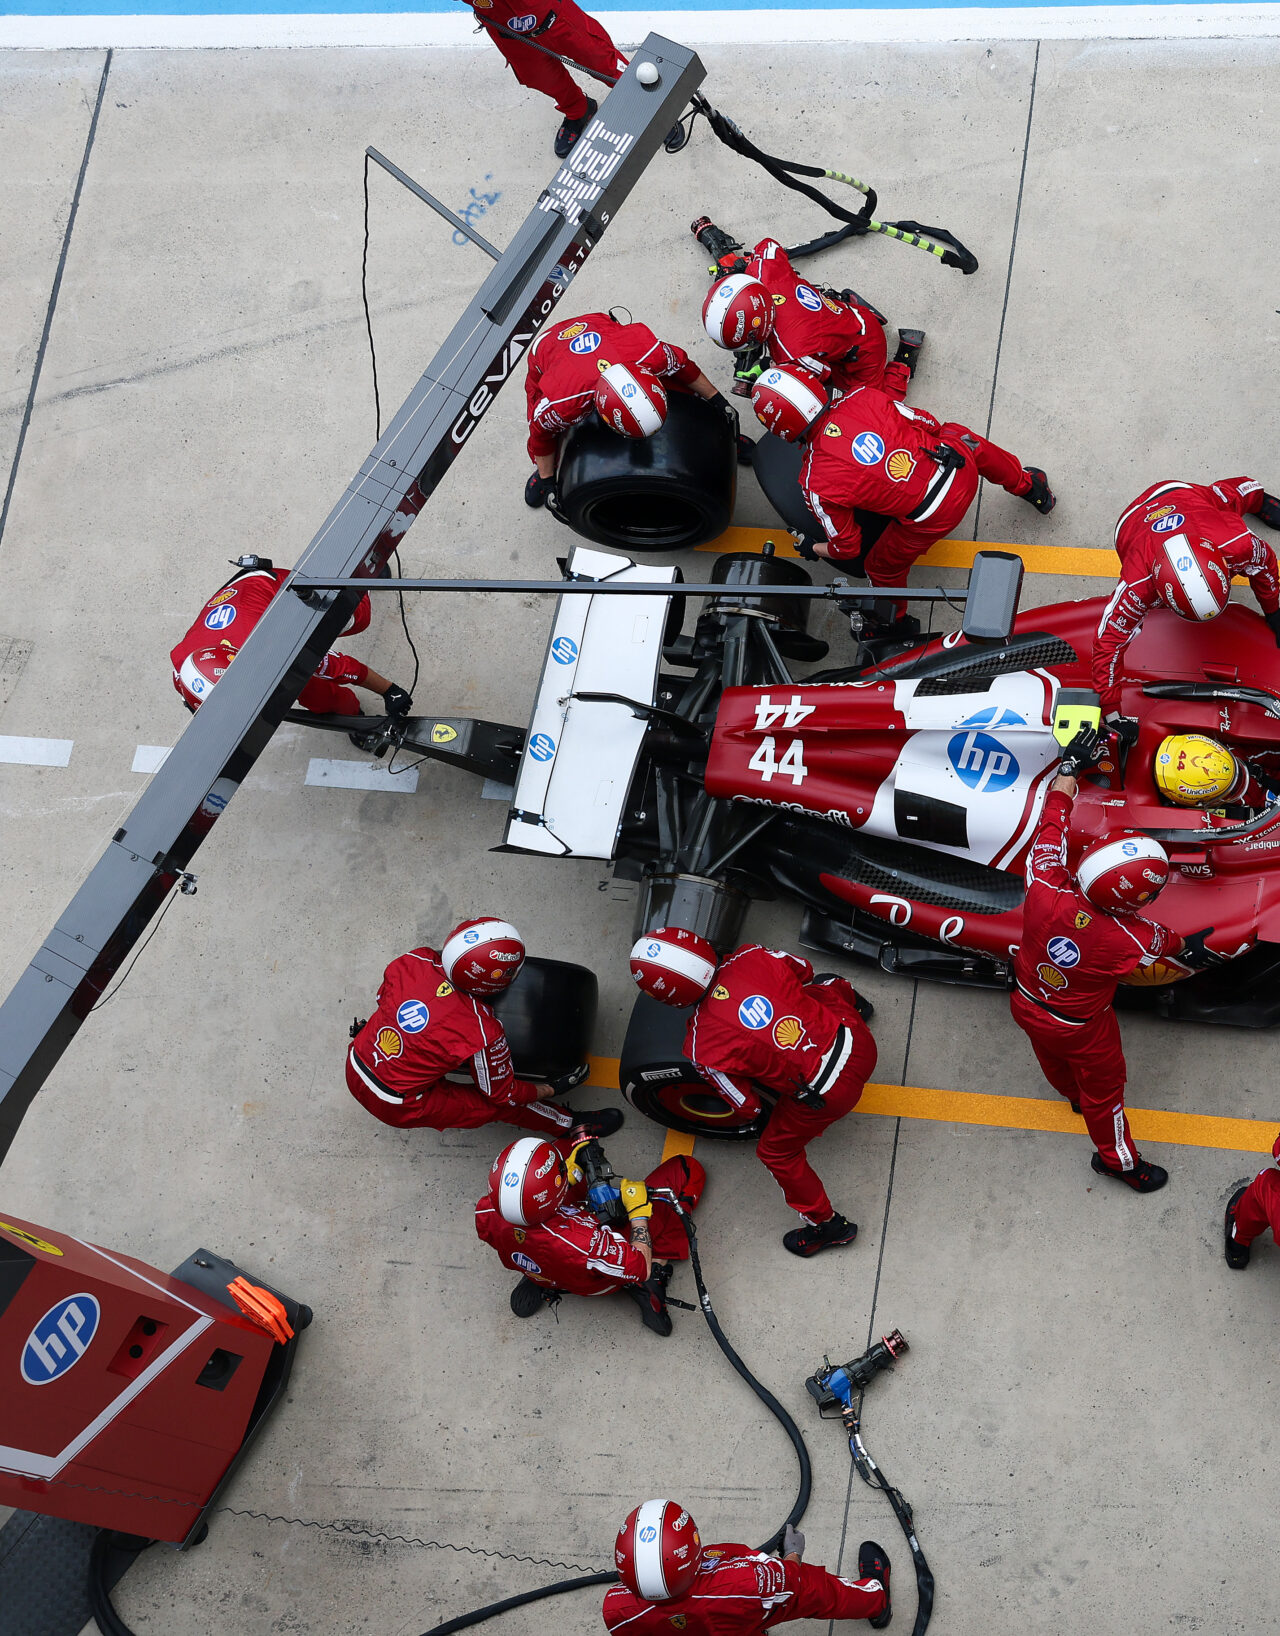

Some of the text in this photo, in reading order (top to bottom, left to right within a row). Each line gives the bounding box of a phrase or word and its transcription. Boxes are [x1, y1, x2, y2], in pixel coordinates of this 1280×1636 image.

[540, 120, 634, 226] IBM
[797, 286, 821, 311] hp
[452, 333, 533, 444] CEVA
[532, 211, 609, 328] LOGISTIS
[574, 332, 598, 353] hp
[768, 372, 781, 384] hp
[622, 384, 636, 397] hp
[854, 433, 883, 465] hp
[1156, 514, 1181, 532] hp
[208, 605, 234, 629] hp
[552, 637, 578, 665] hp
[192, 678, 204, 693] hp
[752, 695, 816, 730] 44
[530, 734, 555, 761] hp
[748, 737, 808, 785] 44
[955, 731, 1014, 792] hp
[1177, 750, 1186, 771] 44
[1186, 786, 1218, 795] UniCredit
[1181, 864, 1210, 875] aws
[647, 943, 660, 957] hp
[1049, 937, 1078, 966] hp
[398, 1001, 427, 1032] hp
[741, 996, 770, 1029] hp
[641, 1067, 683, 1082] PIRELLI
[505, 1172, 519, 1187] hp
[514, 1253, 538, 1272] hp
[27, 1300, 87, 1376] hp
[640, 1526, 656, 1543] hp
